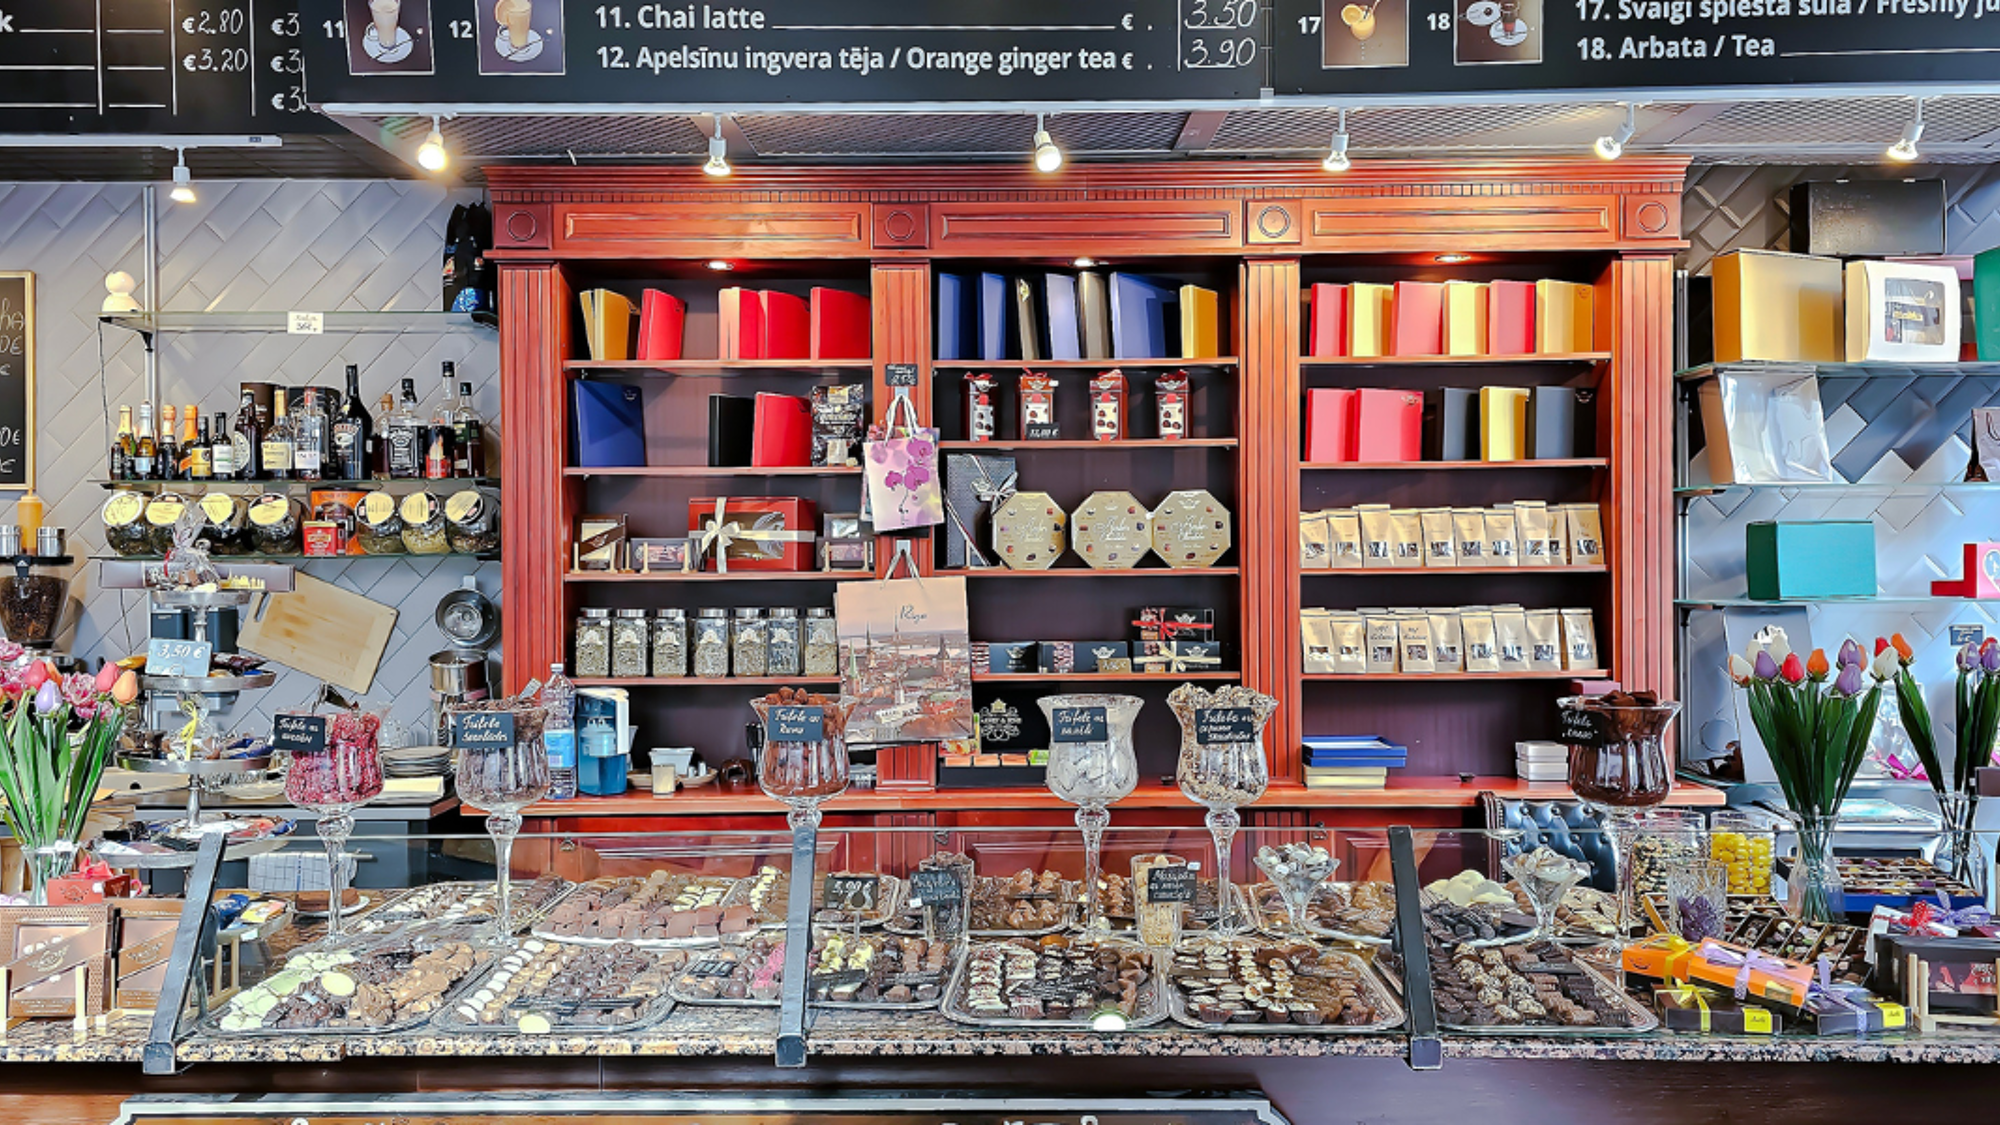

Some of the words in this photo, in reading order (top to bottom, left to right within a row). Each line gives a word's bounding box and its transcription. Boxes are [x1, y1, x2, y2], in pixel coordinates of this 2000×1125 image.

[595, 5, 632, 29] 11.
[637, 4, 696, 30] Chai
[702, 4, 766, 30] latte
[1575, 0, 1611, 21] 17.
[322, 19, 346, 39] 11
[449, 20, 474, 39] 12
[1297, 16, 1321, 35] 17
[1427, 12, 1451, 31] 18
[1576, 37, 1612, 61] 18.
[1618, 35, 1707, 60] Arbata
[1731, 34, 1775, 57] Tea
[597, 46, 630, 69] 12.
[636, 45, 739, 76] Apelsīnu
[745, 46, 832, 76] ingvera
[838, 46, 884, 76] tēja
[906, 46, 993, 76] Orange
[998, 46, 1073, 76] ginger
[1078, 48, 1117, 70] tea
